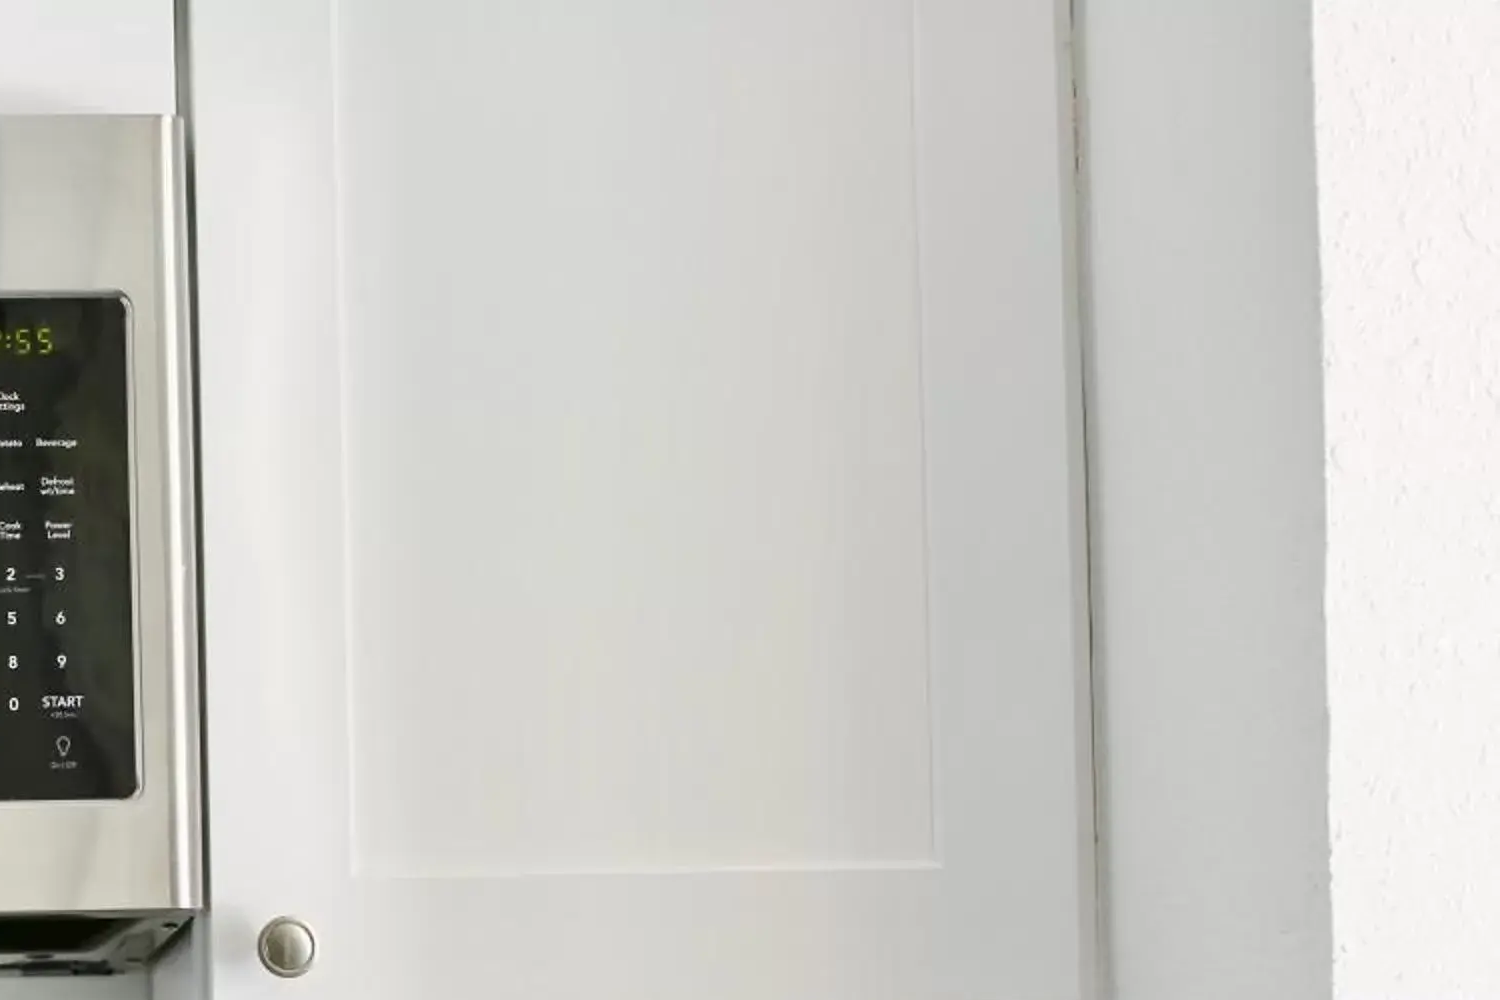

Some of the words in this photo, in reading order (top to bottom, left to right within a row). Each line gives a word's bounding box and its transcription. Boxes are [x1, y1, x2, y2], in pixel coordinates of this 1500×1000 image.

[35, 437, 79, 449] Beverage
[44, 520, 73, 530] Power
[47, 529, 71, 540] Level
[5, 567, 17, 582] 2
[54, 566, 65, 581] 3
[7, 611, 17, 626] 5
[55, 610, 67, 625] 6
[7, 655, 19, 670] 8
[56, 654, 67, 669] 9
[8, 696, 20, 712] 0
[41, 694, 85, 709] START
